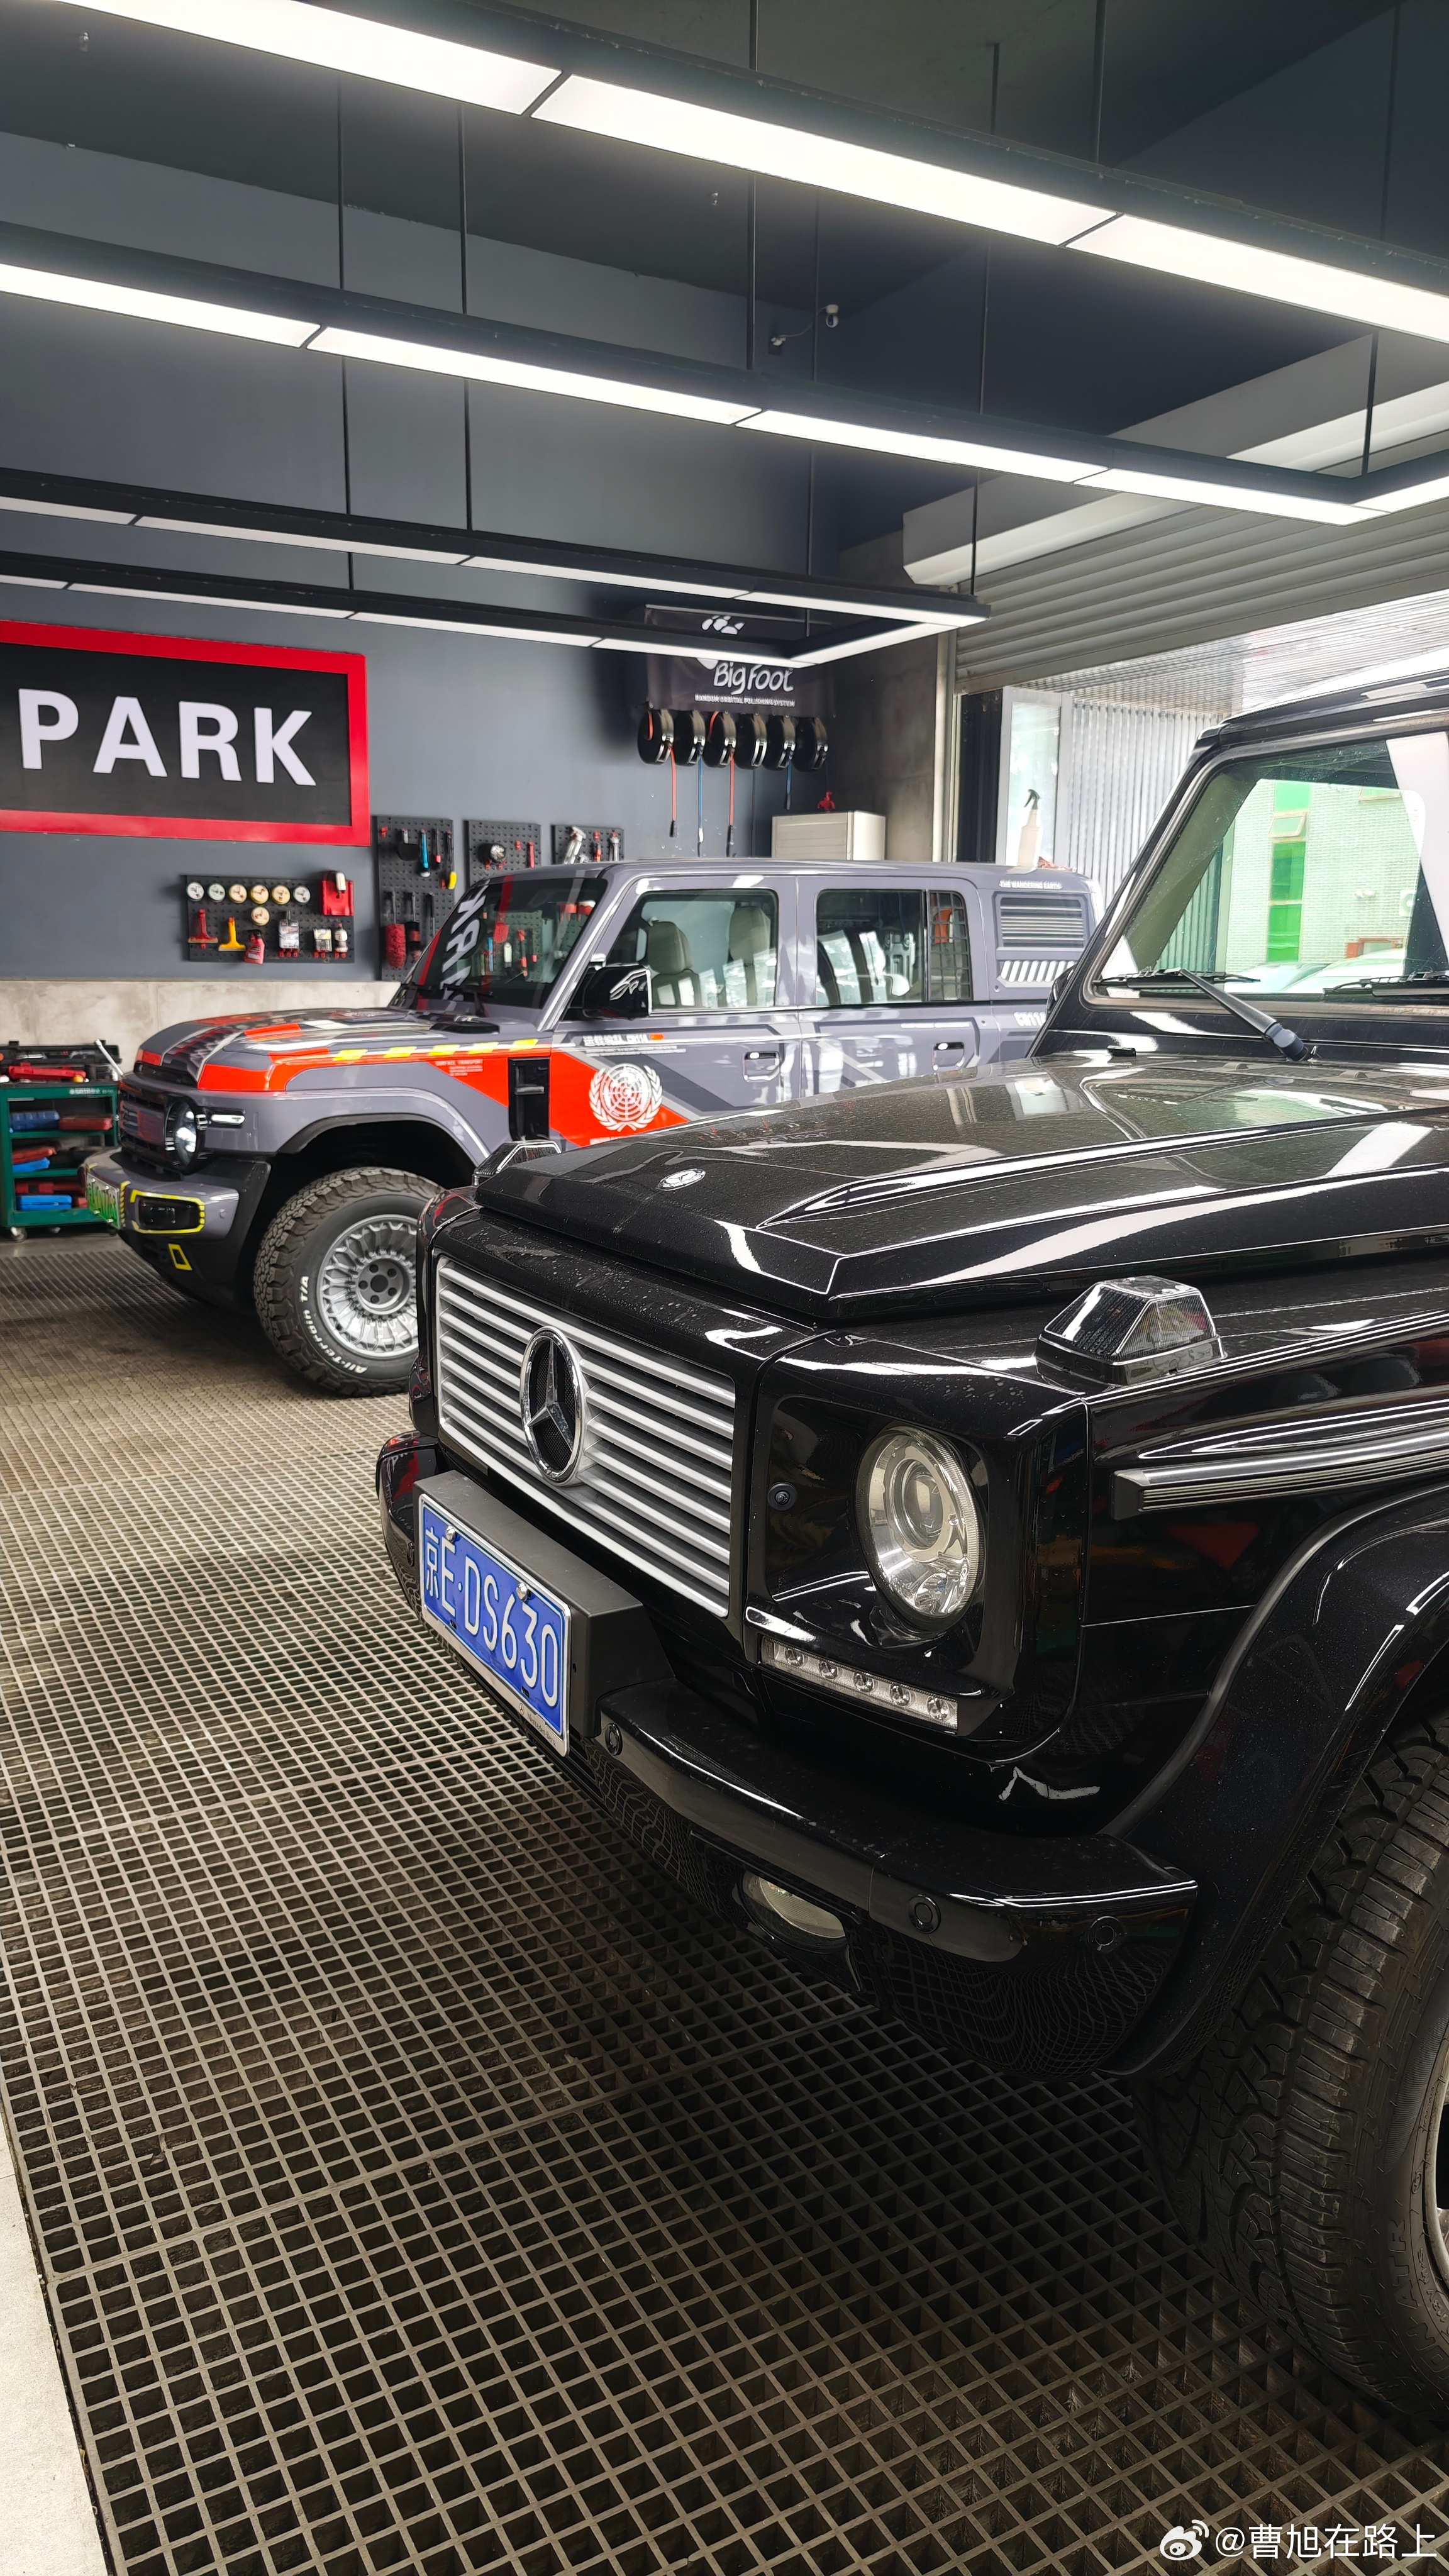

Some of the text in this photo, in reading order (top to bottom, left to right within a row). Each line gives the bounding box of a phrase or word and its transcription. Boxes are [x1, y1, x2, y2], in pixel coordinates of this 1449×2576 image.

[18, 688, 317, 786] PARK
[299, 1275, 309, 1303] T/A
[527, 1712, 557, 1747] Mercedes-Benz
[1388, 2219, 1419, 2309] ATR
